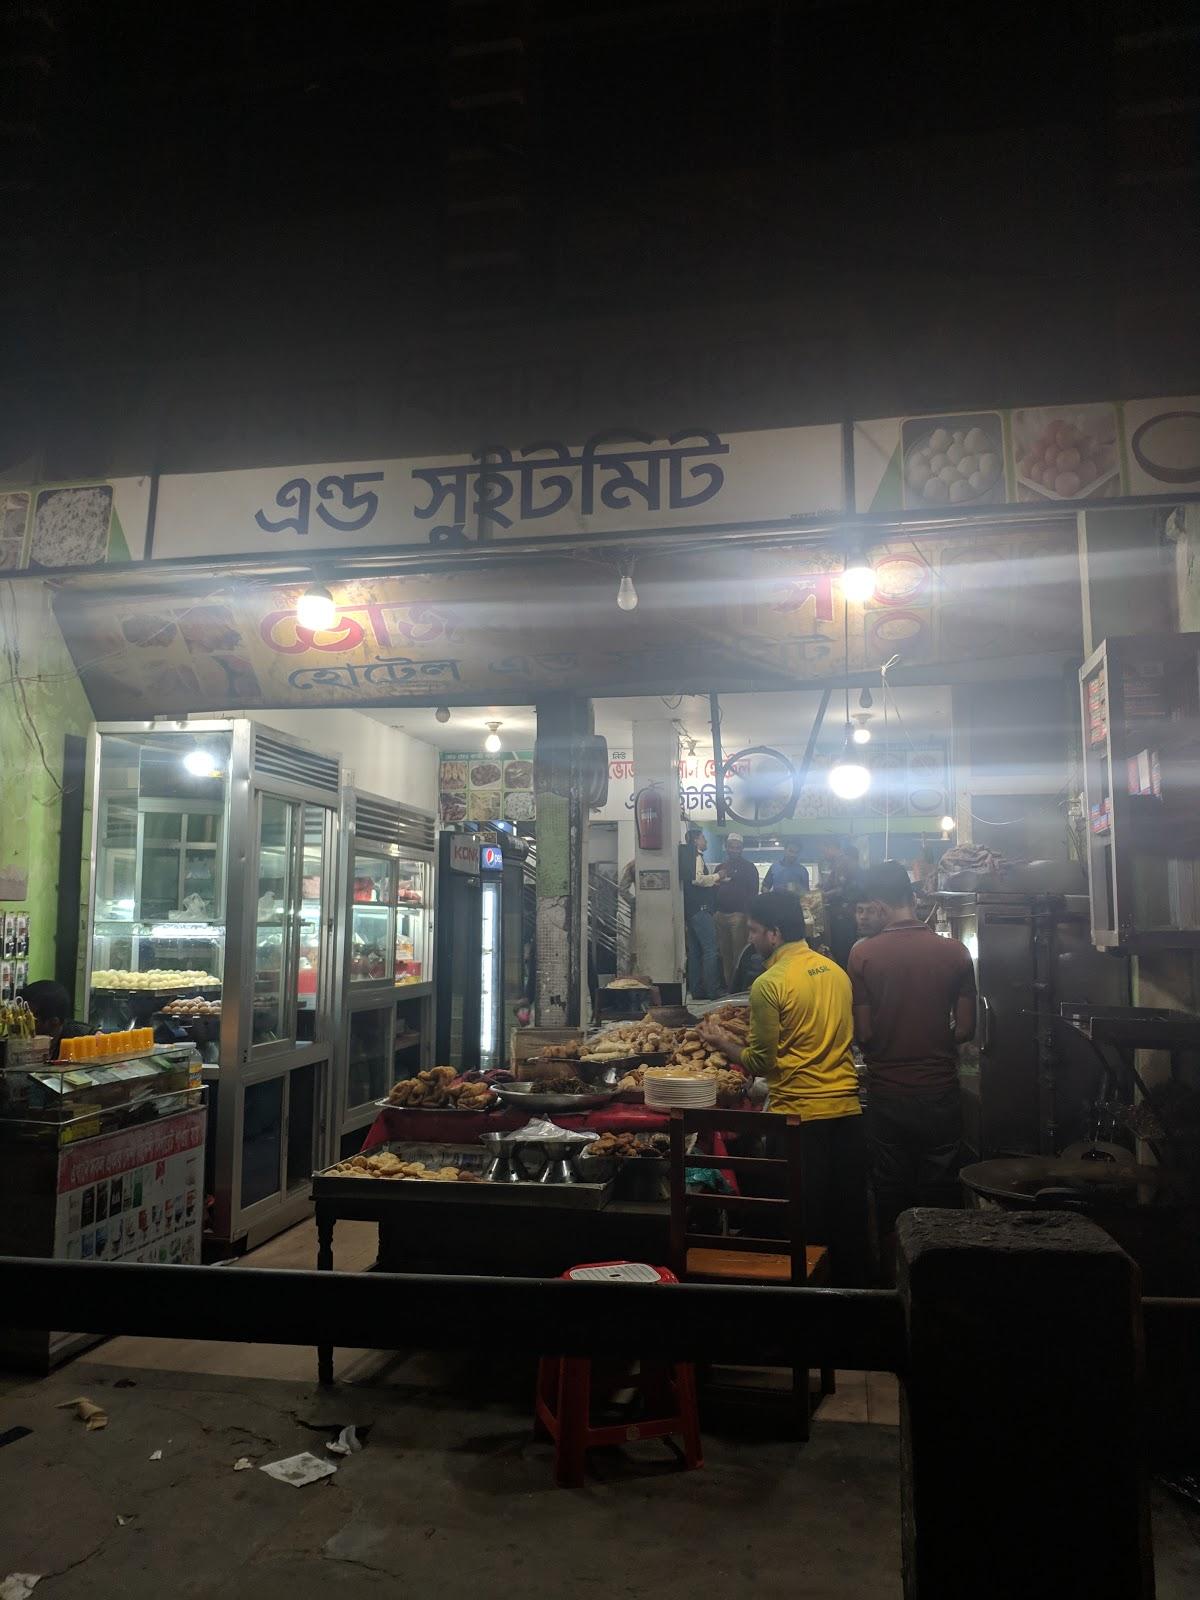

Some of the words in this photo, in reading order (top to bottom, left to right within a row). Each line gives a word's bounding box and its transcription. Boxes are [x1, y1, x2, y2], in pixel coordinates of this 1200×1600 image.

[254, 471, 384, 536] এন্ড
[410, 428, 731, 545] সুইটমিট
[288, 655, 462, 690] হোটেল
